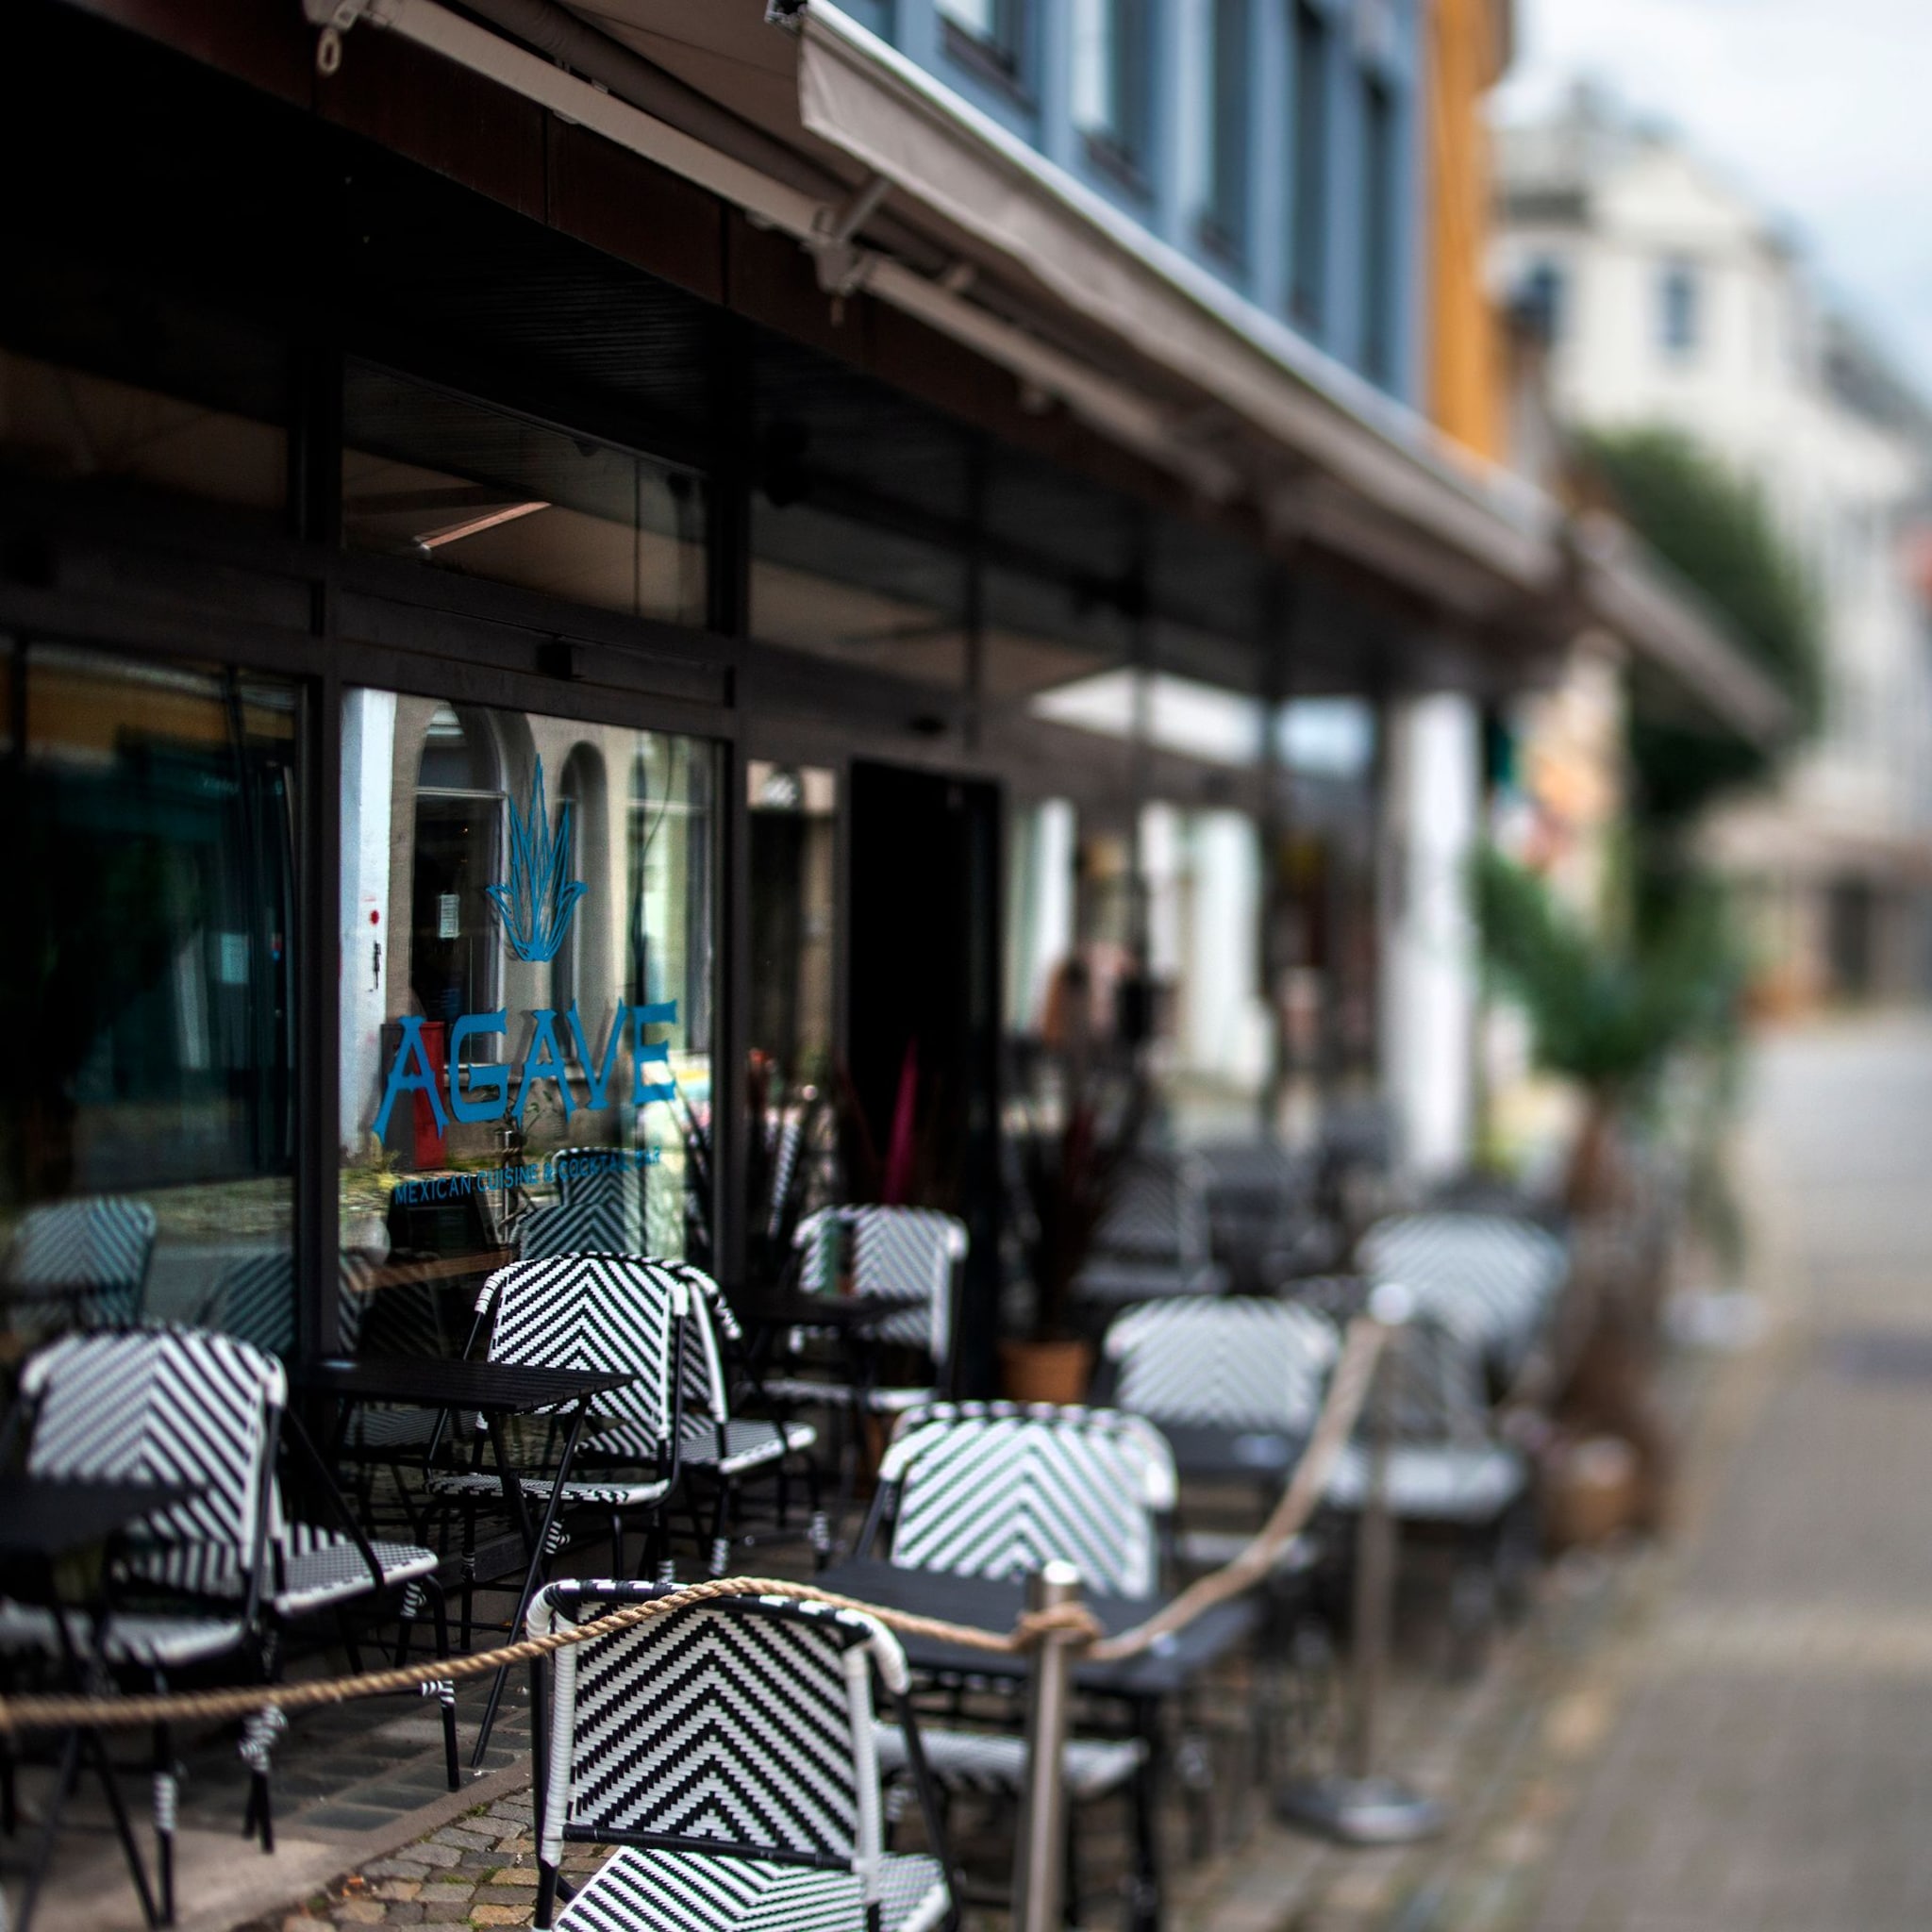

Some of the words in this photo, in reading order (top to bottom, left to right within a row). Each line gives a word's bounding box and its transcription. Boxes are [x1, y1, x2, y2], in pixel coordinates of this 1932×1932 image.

[373, 998, 677, 1144] AGAVE
[394, 1175, 472, 1205] MEXICAN
[476, 1165, 537, 1192] CUISINE
[543, 1162, 554, 1183] &
